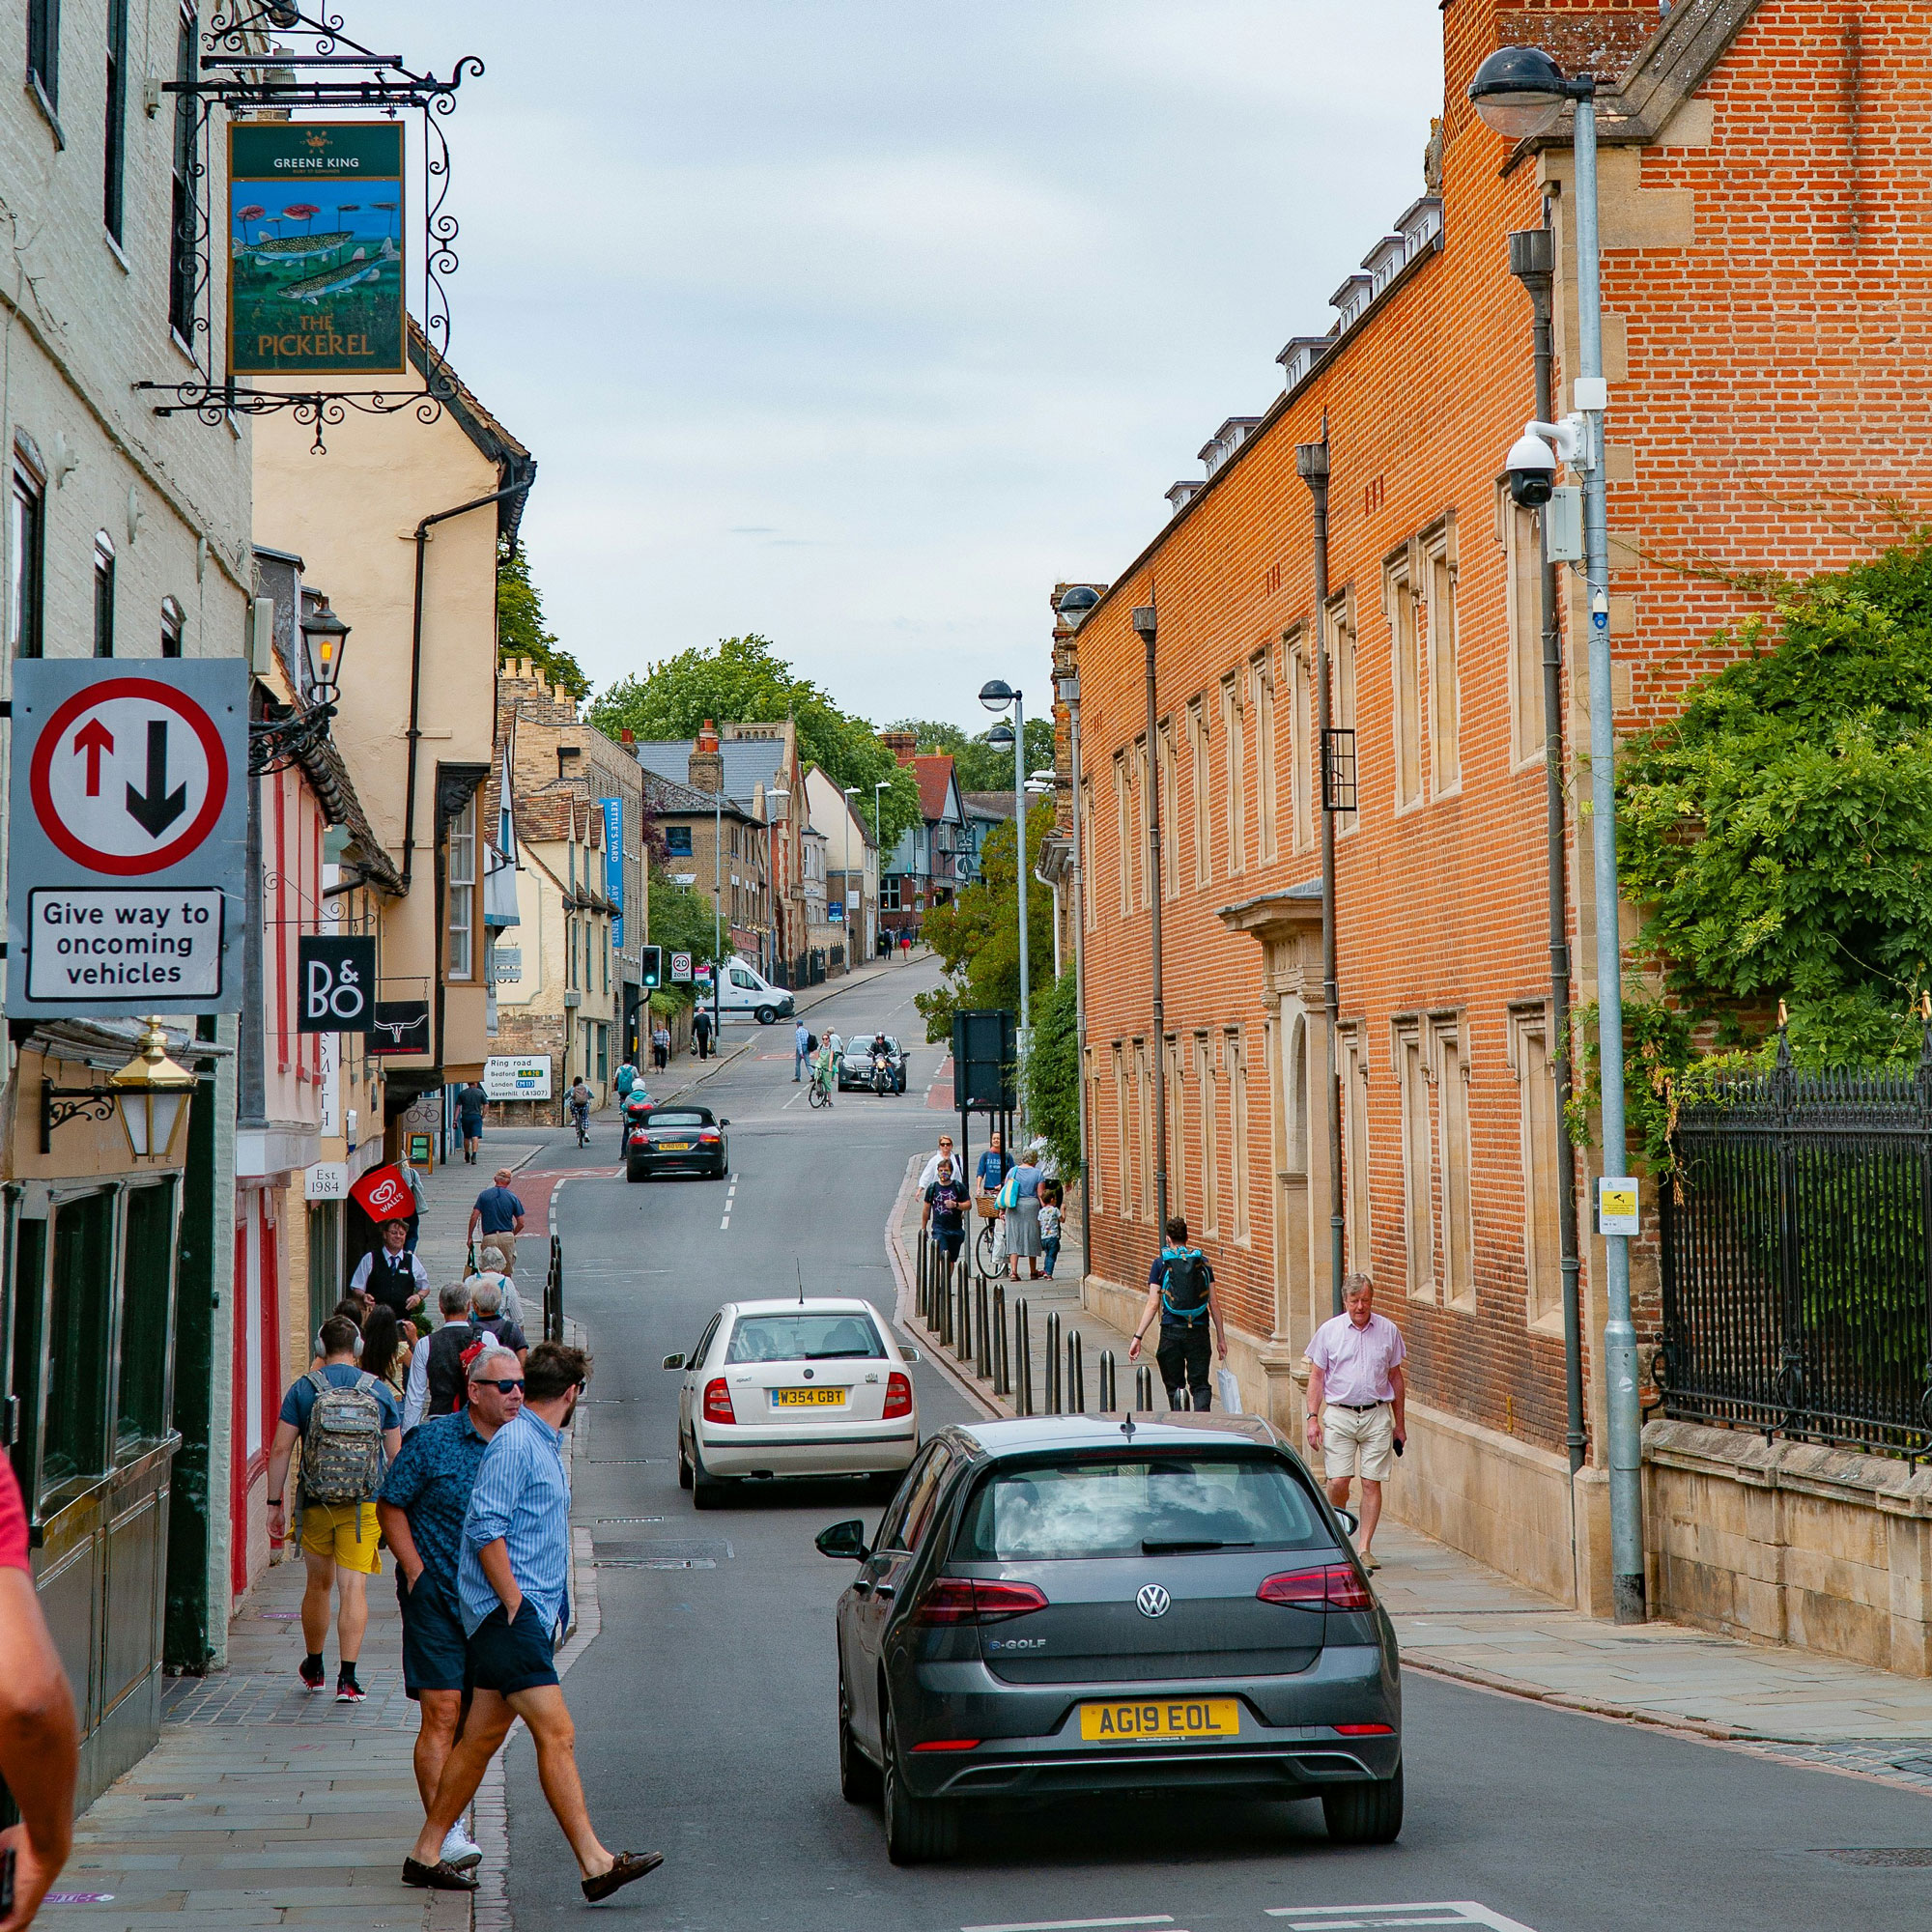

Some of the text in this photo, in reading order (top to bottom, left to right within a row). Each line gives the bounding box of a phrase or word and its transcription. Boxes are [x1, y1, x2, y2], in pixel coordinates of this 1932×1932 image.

[273, 157, 359, 168] GREENE KING
[298, 315, 334, 330] THE
[258, 334, 375, 355] PICKEREL
[611, 801, 619, 863] KETTLE'S YARD
[611, 885, 619, 901] ART
[43, 902, 210, 928] Give way to
[57, 932, 193, 957] oncoming
[67, 962, 182, 984] vehicles
[307, 959, 364, 1018] B&O
[316, 1169, 338, 1180] Est.
[311, 1181, 339, 1193] 1984
[380, 1192, 405, 1214] WALL'S
[781, 1390, 842, 1404] W354 GBT
[1099, 1705, 1221, 1734] AG19 EOL
